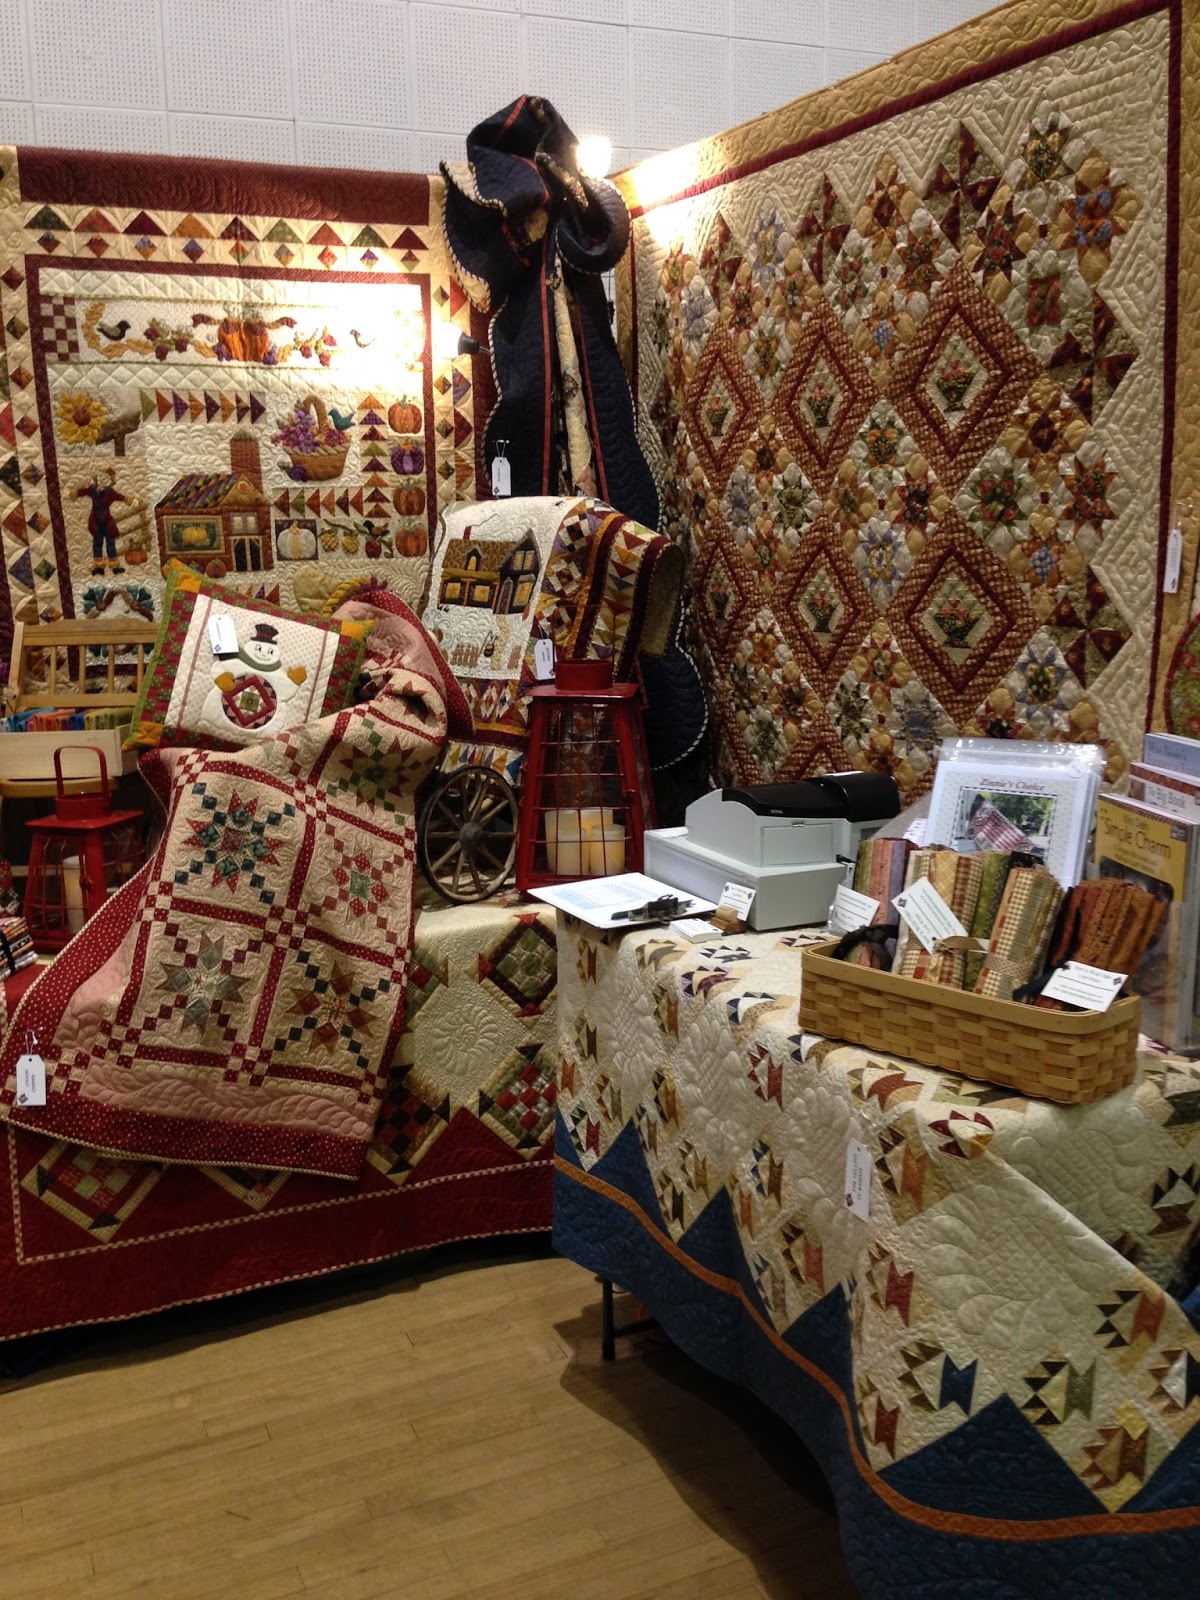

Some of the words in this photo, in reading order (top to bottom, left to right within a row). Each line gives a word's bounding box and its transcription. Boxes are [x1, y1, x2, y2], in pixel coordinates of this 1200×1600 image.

[1015, 781, 1045, 792] Choice
[1104, 817, 1133, 846] Simple
[1135, 830, 1171, 860] Charm
